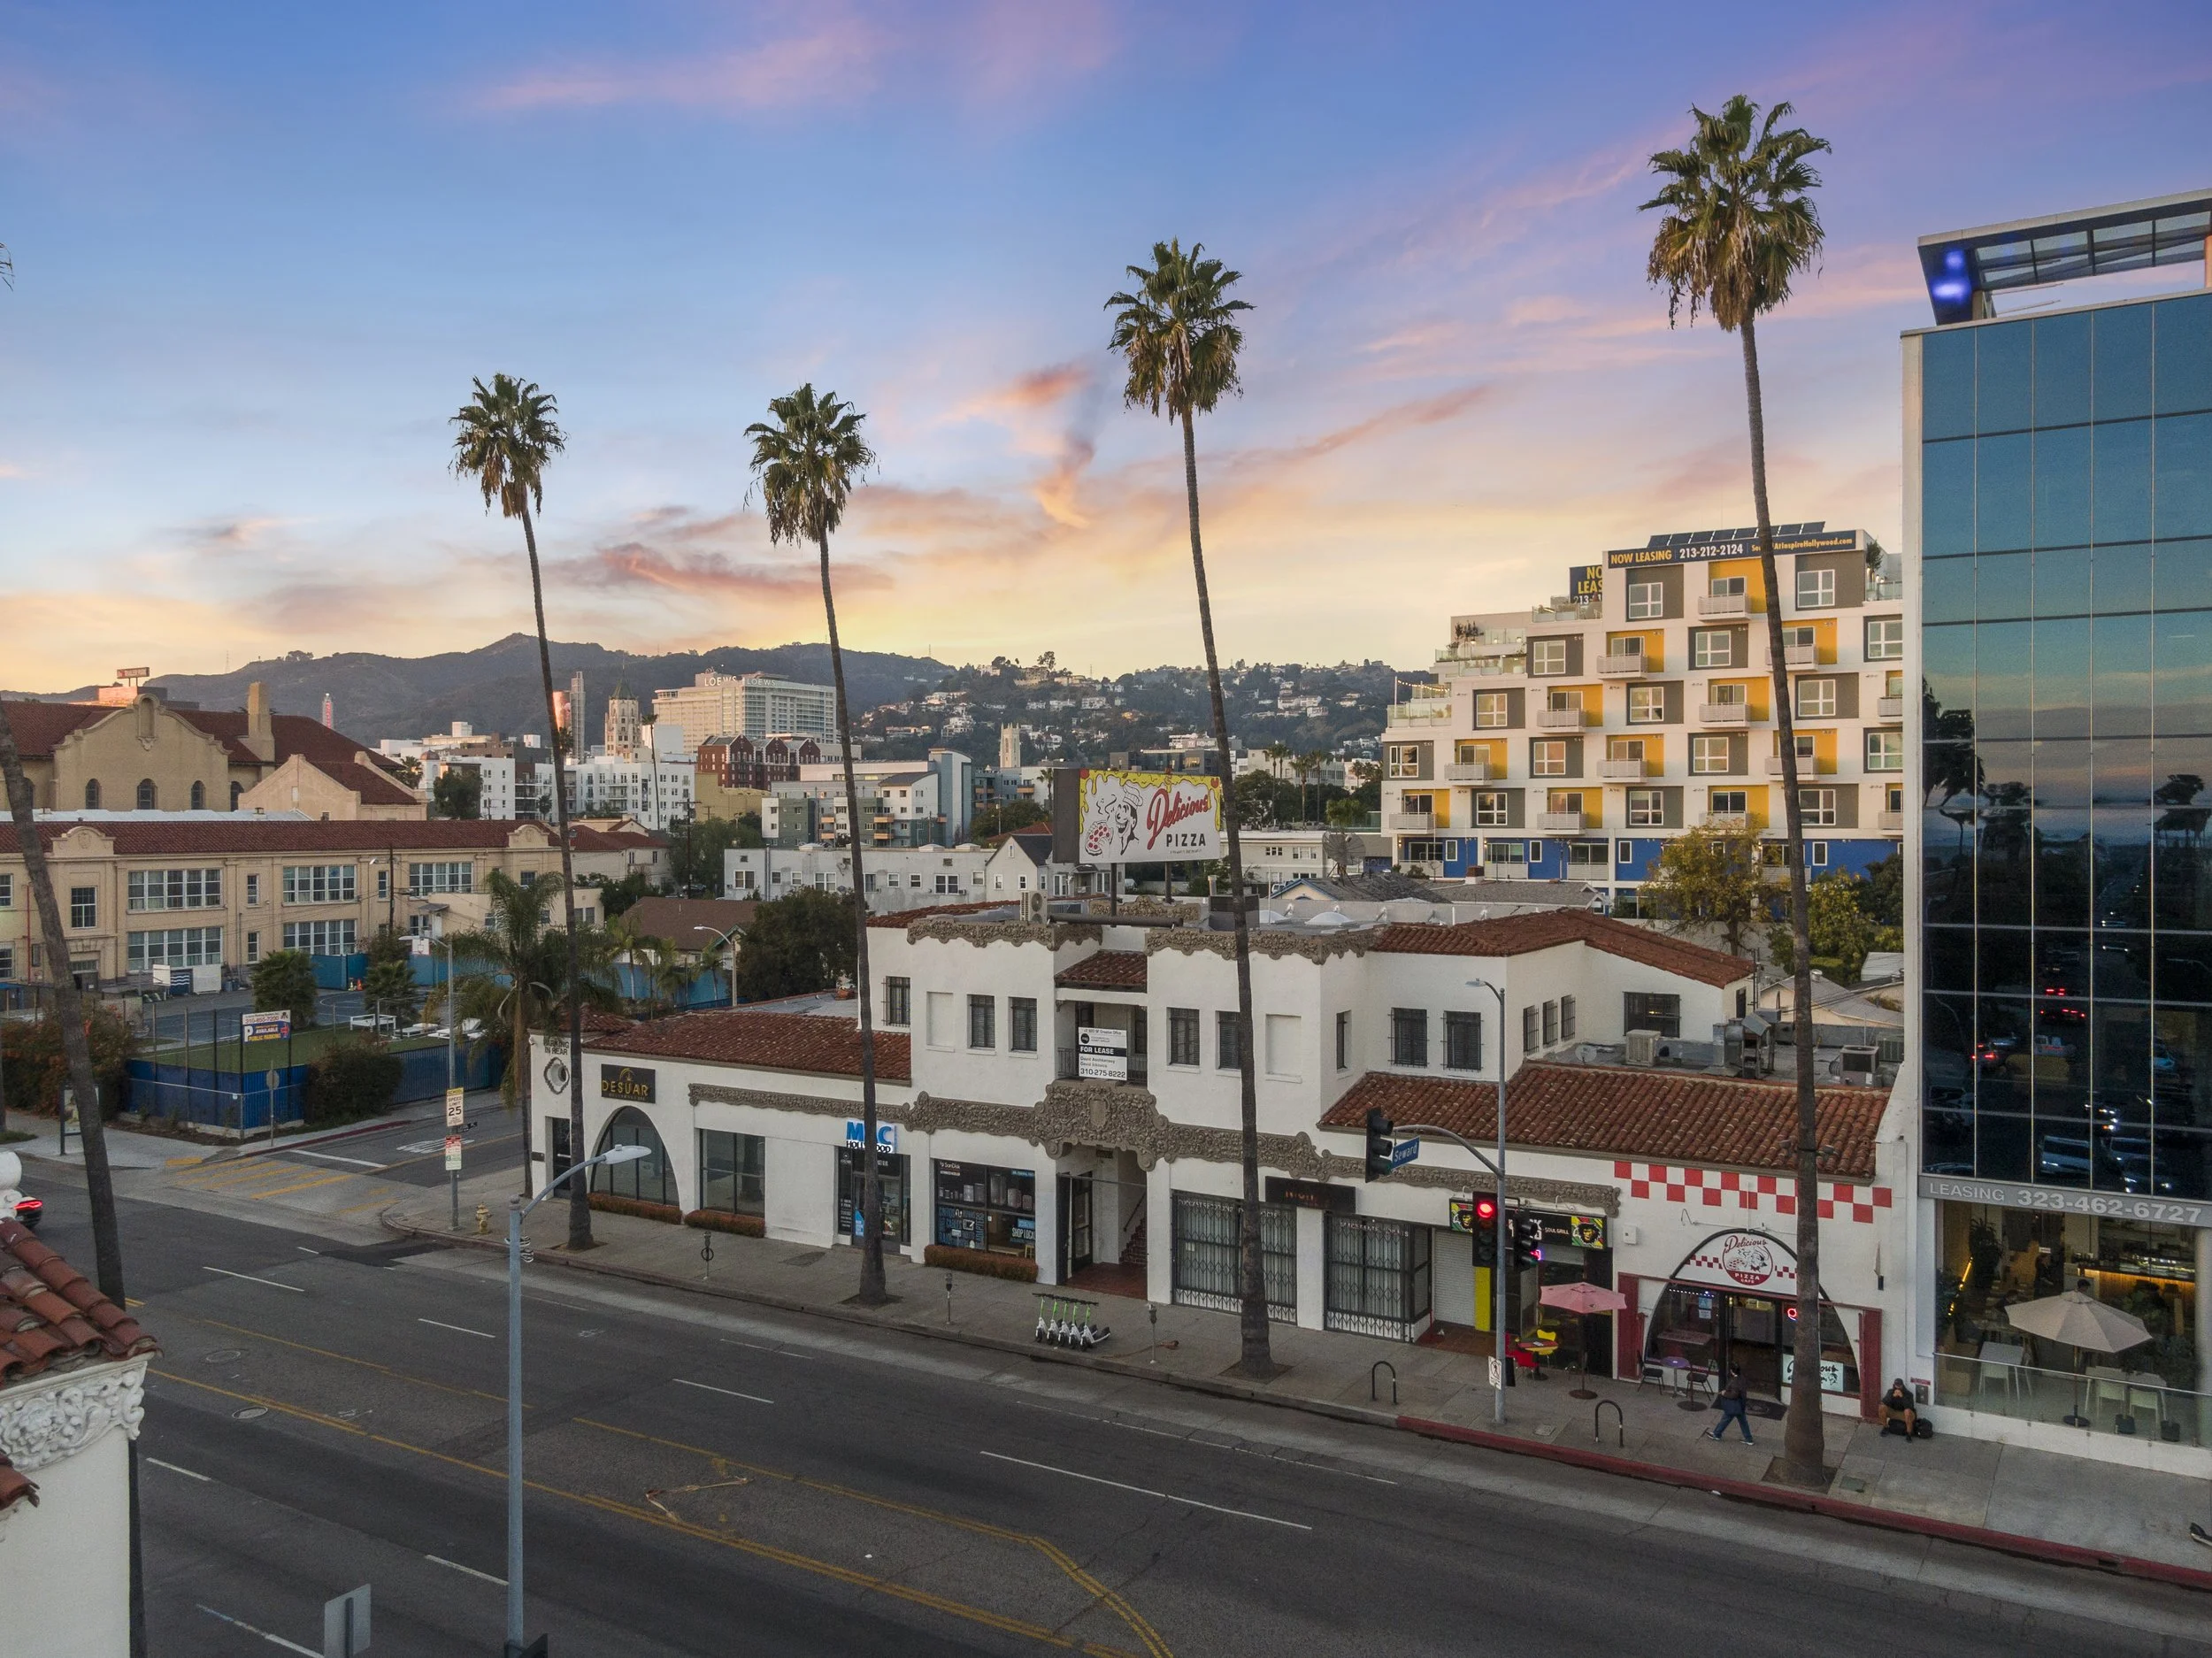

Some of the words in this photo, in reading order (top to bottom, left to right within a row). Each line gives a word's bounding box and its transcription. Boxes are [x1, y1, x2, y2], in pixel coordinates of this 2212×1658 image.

[1610, 553, 1633, 564] NOW
[1636, 549, 1672, 563] LEASING
[1679, 543, 1744, 559] 213-212-2124
[1586, 565, 1602, 580] NO
[1578, 580, 1602, 595] LEAS
[704, 676, 737, 687] LOEWS
[1147, 788, 1209, 850] Delicious
[1166, 833, 1206, 847] PIZZA
[552, 1047, 568, 1055] REAR
[603, 1080, 649, 1096] DESUAR
[449, 1106, 462, 1117] 25
[847, 1121, 892, 1145] MC
[847, 1140, 892, 1153] HOLLOOD
[1394, 1142, 1417, 1163] Seward
[1930, 1183, 2005, 1201] LEASING
[2017, 1190, 2201, 1223] 323-462-6727
[1011, 1227, 1023, 1238] SHOP
[1724, 1235, 1768, 1253] Delicious
